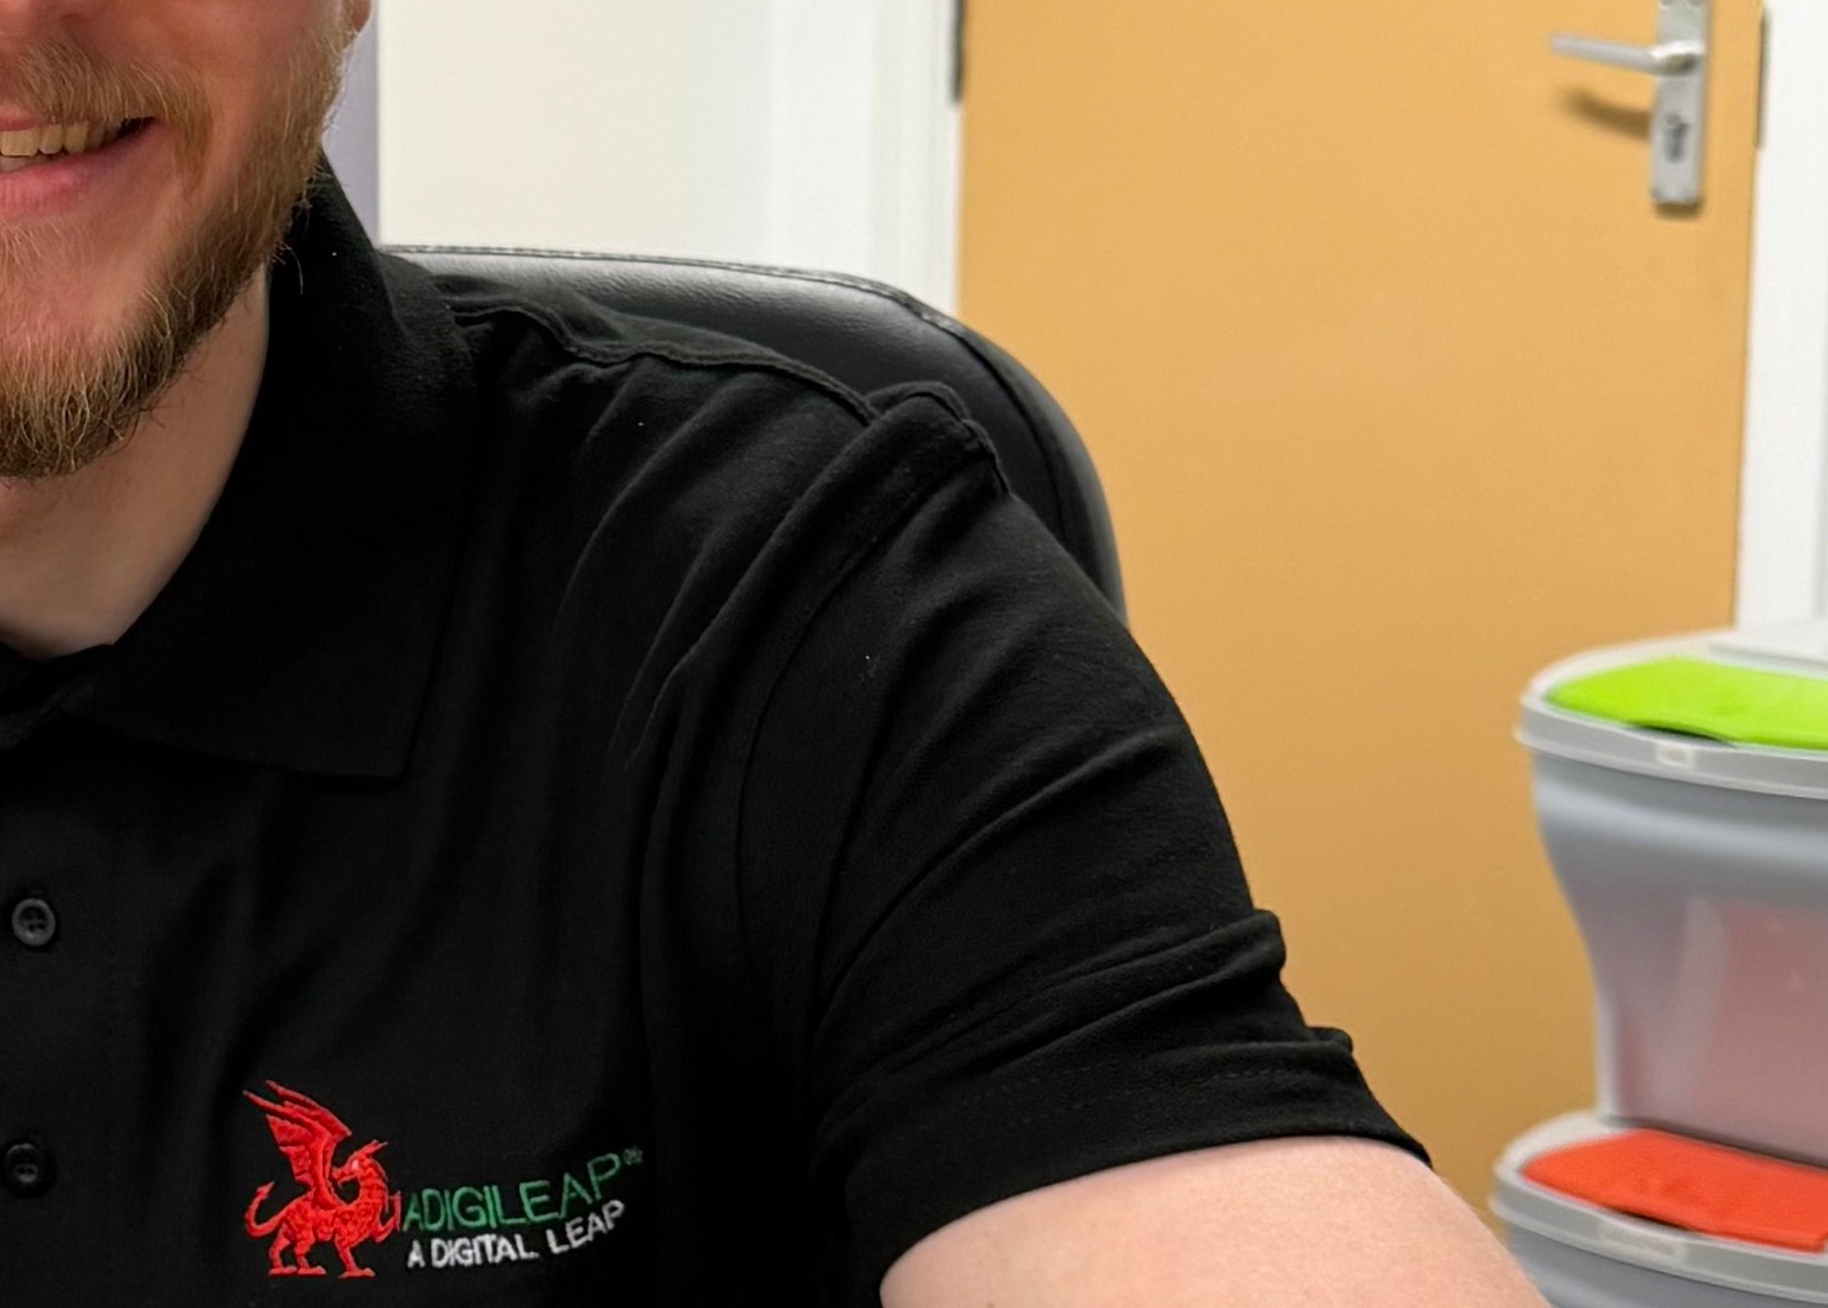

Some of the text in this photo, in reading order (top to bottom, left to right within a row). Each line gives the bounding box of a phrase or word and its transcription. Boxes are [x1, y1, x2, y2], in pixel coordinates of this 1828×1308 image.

[407, 1199, 625, 1269] A DIGITAL LEAP
